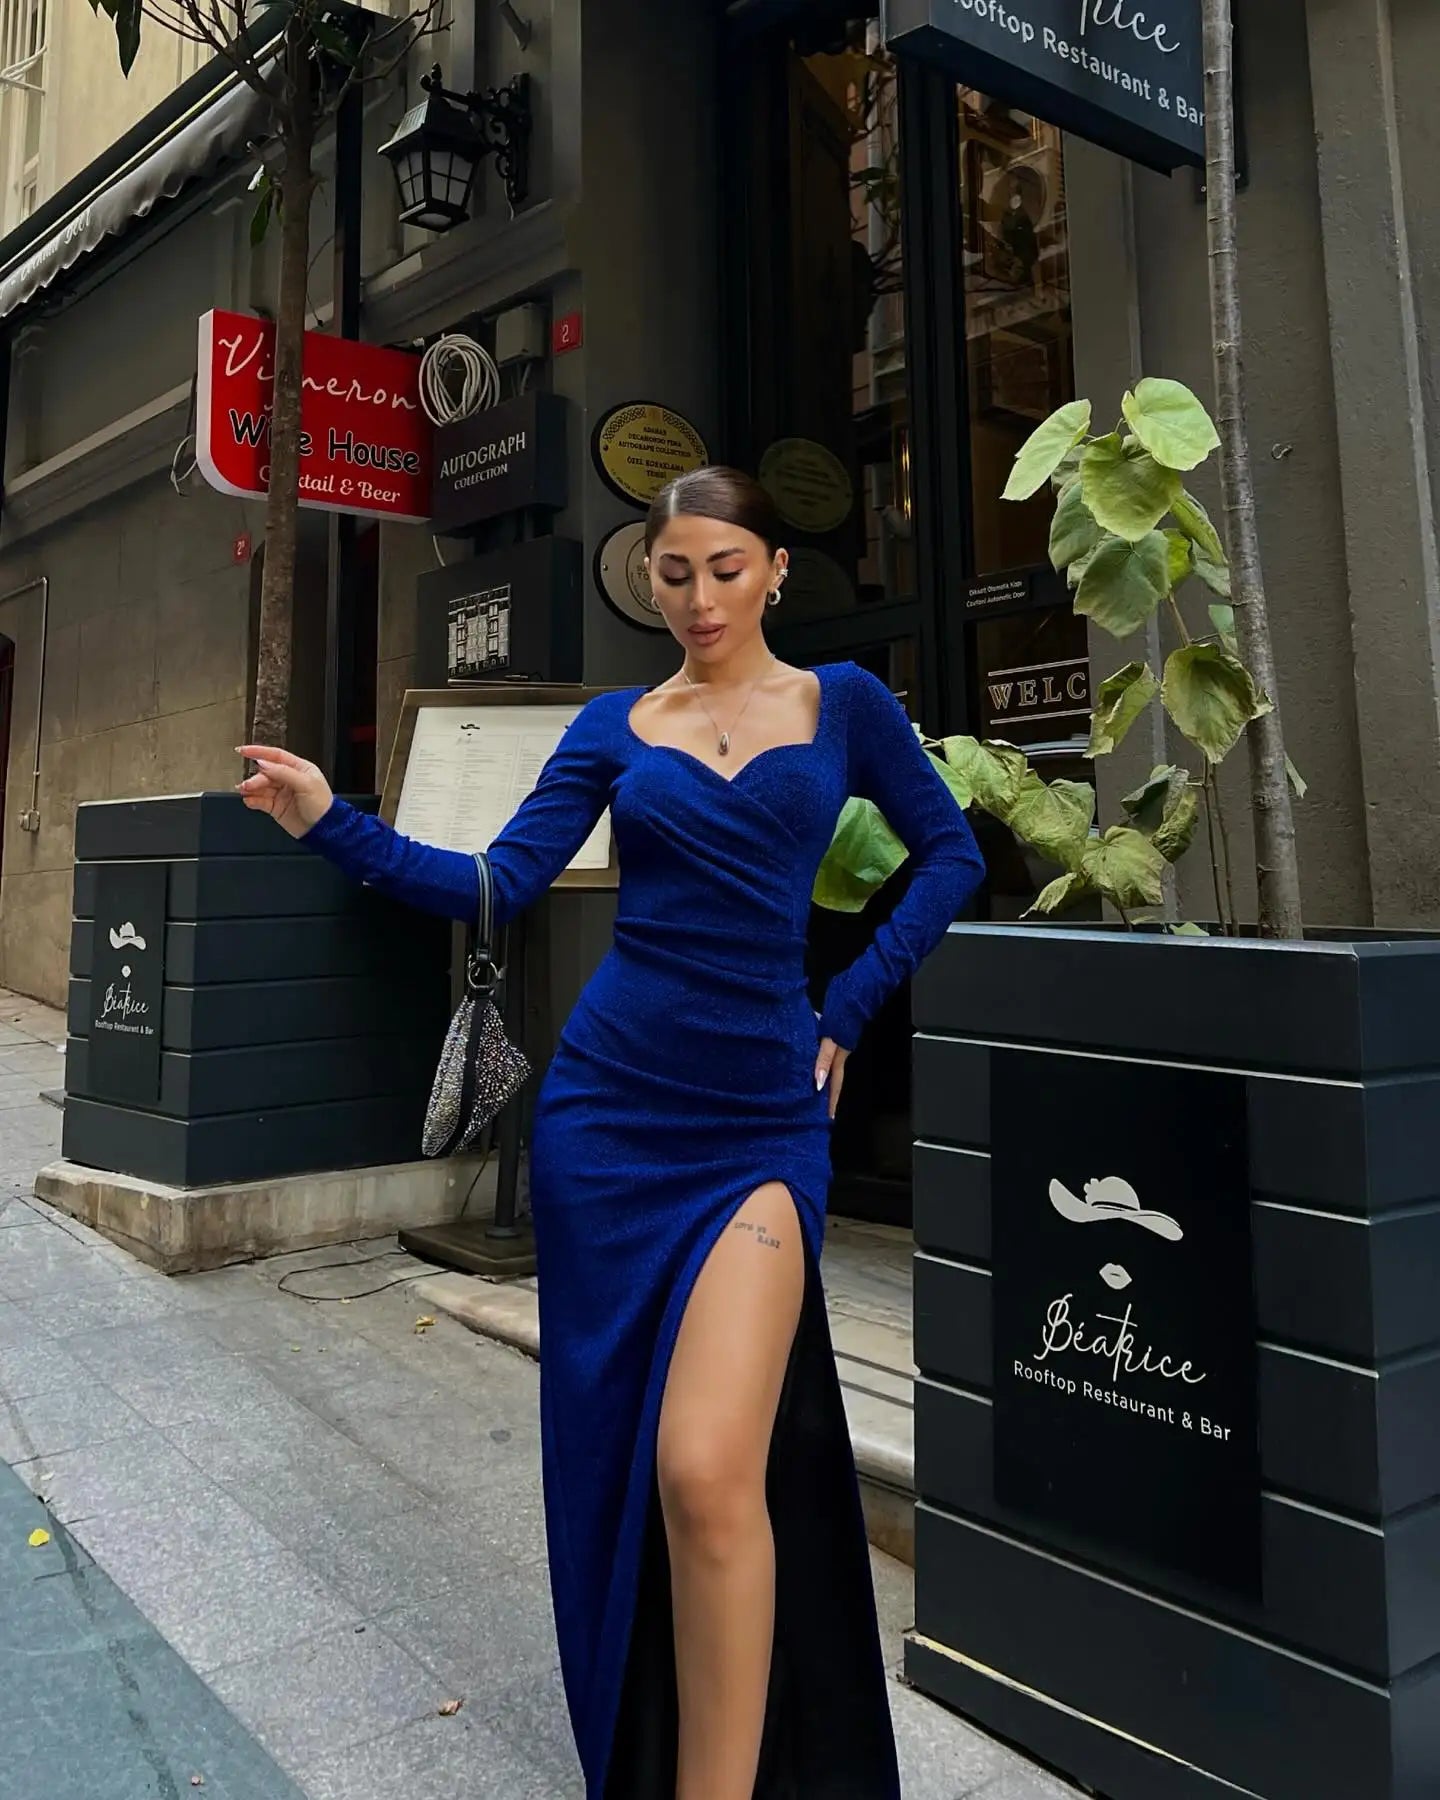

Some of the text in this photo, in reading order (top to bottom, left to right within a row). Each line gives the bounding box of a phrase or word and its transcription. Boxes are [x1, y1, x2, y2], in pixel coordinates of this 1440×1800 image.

[1043, 27, 1151, 100] Restaurant
[1158, 87, 1170, 110] &
[1176, 95, 1206, 126] Bar
[562, 324, 570, 343] 2
[219, 332, 416, 410] Vineron
[229, 408, 420, 475] Wie House
[440, 431, 526, 479] AUTOGRAPH
[340, 479, 354, 495] &
[358, 481, 400, 502] Beer
[454, 463, 508, 491] COLLECTION
[1033, 1293, 1206, 1383] Béatrice
[1013, 1360, 1231, 1441] Rooftop Restaurant & Bar
